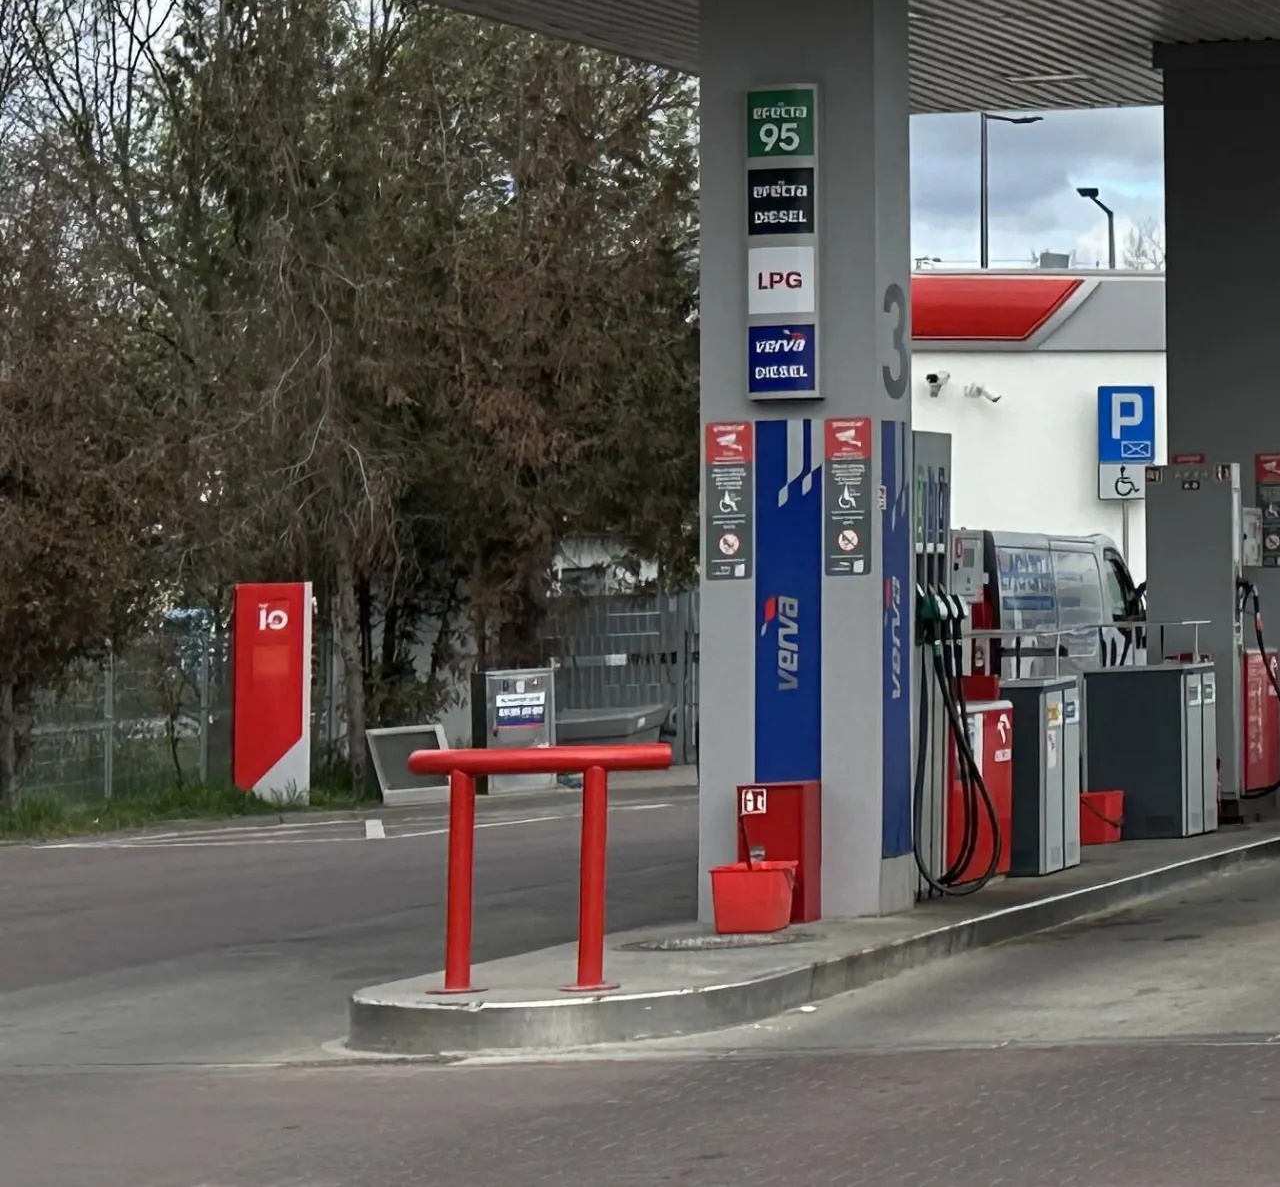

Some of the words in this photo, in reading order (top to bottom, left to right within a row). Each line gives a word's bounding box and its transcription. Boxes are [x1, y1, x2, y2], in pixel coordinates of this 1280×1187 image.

[759, 123, 800, 152] 95
[754, 211, 807, 225] DIESEL
[757, 272, 803, 291] LPG
[882, 283, 907, 400] 3
[754, 363, 808, 379] DIESEL
[1111, 393, 1144, 439] P
[777, 595, 799, 691] verva
